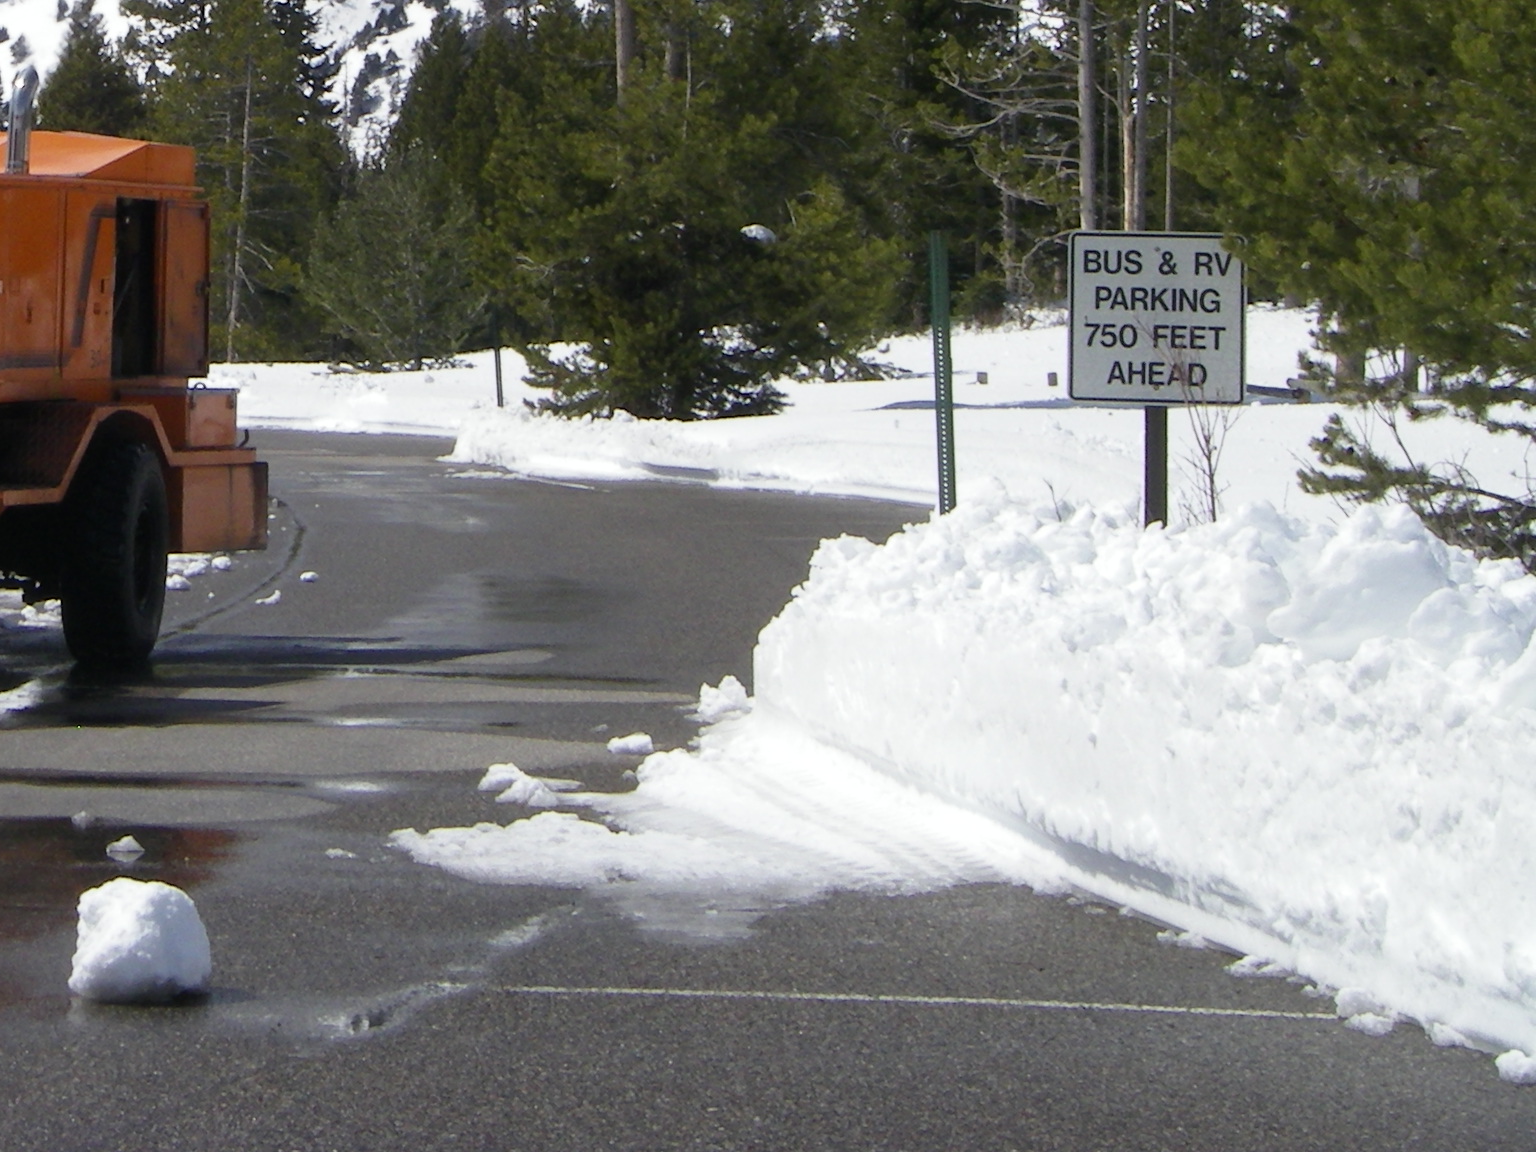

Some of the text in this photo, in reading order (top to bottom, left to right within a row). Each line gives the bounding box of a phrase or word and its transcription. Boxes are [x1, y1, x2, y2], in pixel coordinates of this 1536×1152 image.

[1083, 250, 1232, 276] BUS & RV
[1095, 286, 1221, 313] PARKING
[1084, 323, 1226, 350] 750 FEET
[1107, 361, 1207, 387] AHEAD
